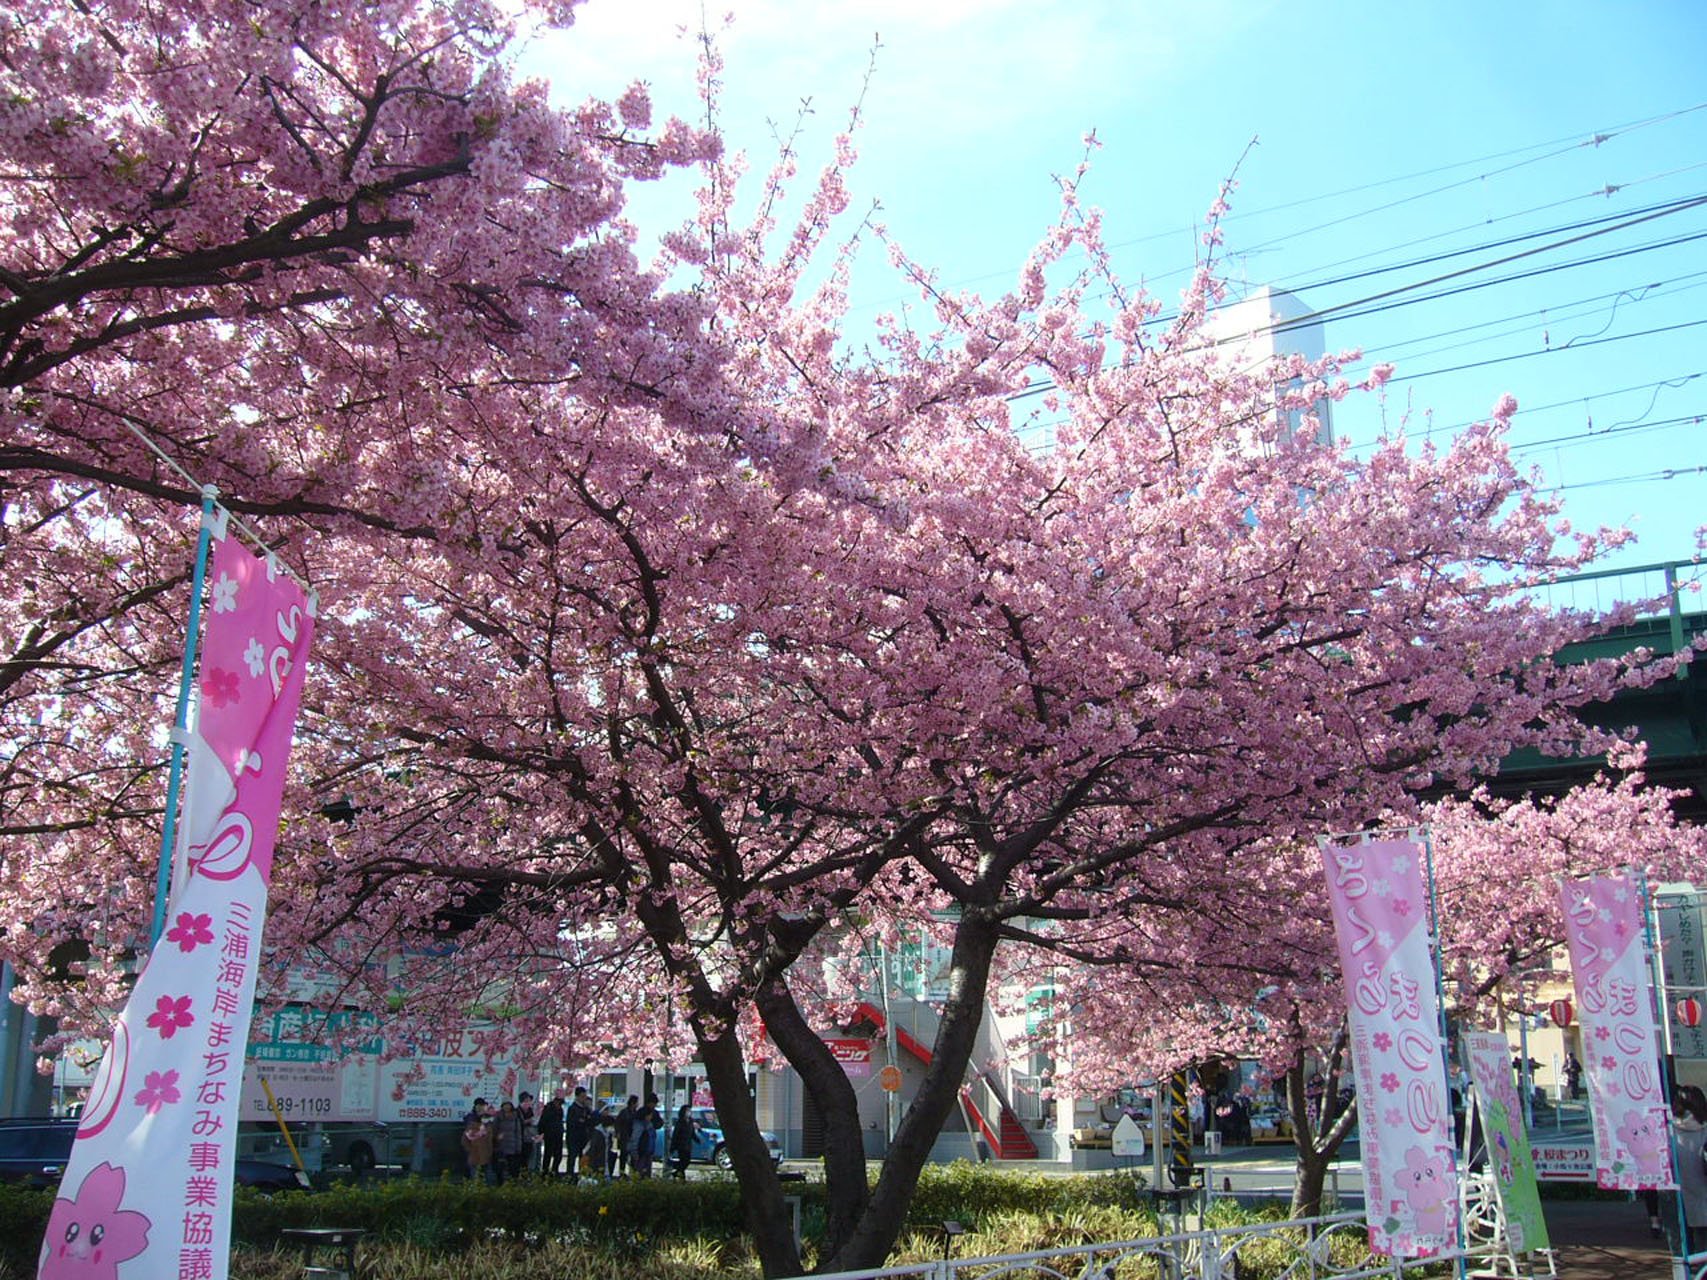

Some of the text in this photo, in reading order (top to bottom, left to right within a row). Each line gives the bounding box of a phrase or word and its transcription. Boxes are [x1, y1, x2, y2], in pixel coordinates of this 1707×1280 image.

[178, 901, 252, 1280] 三浦海岸まちなみ事業協議
